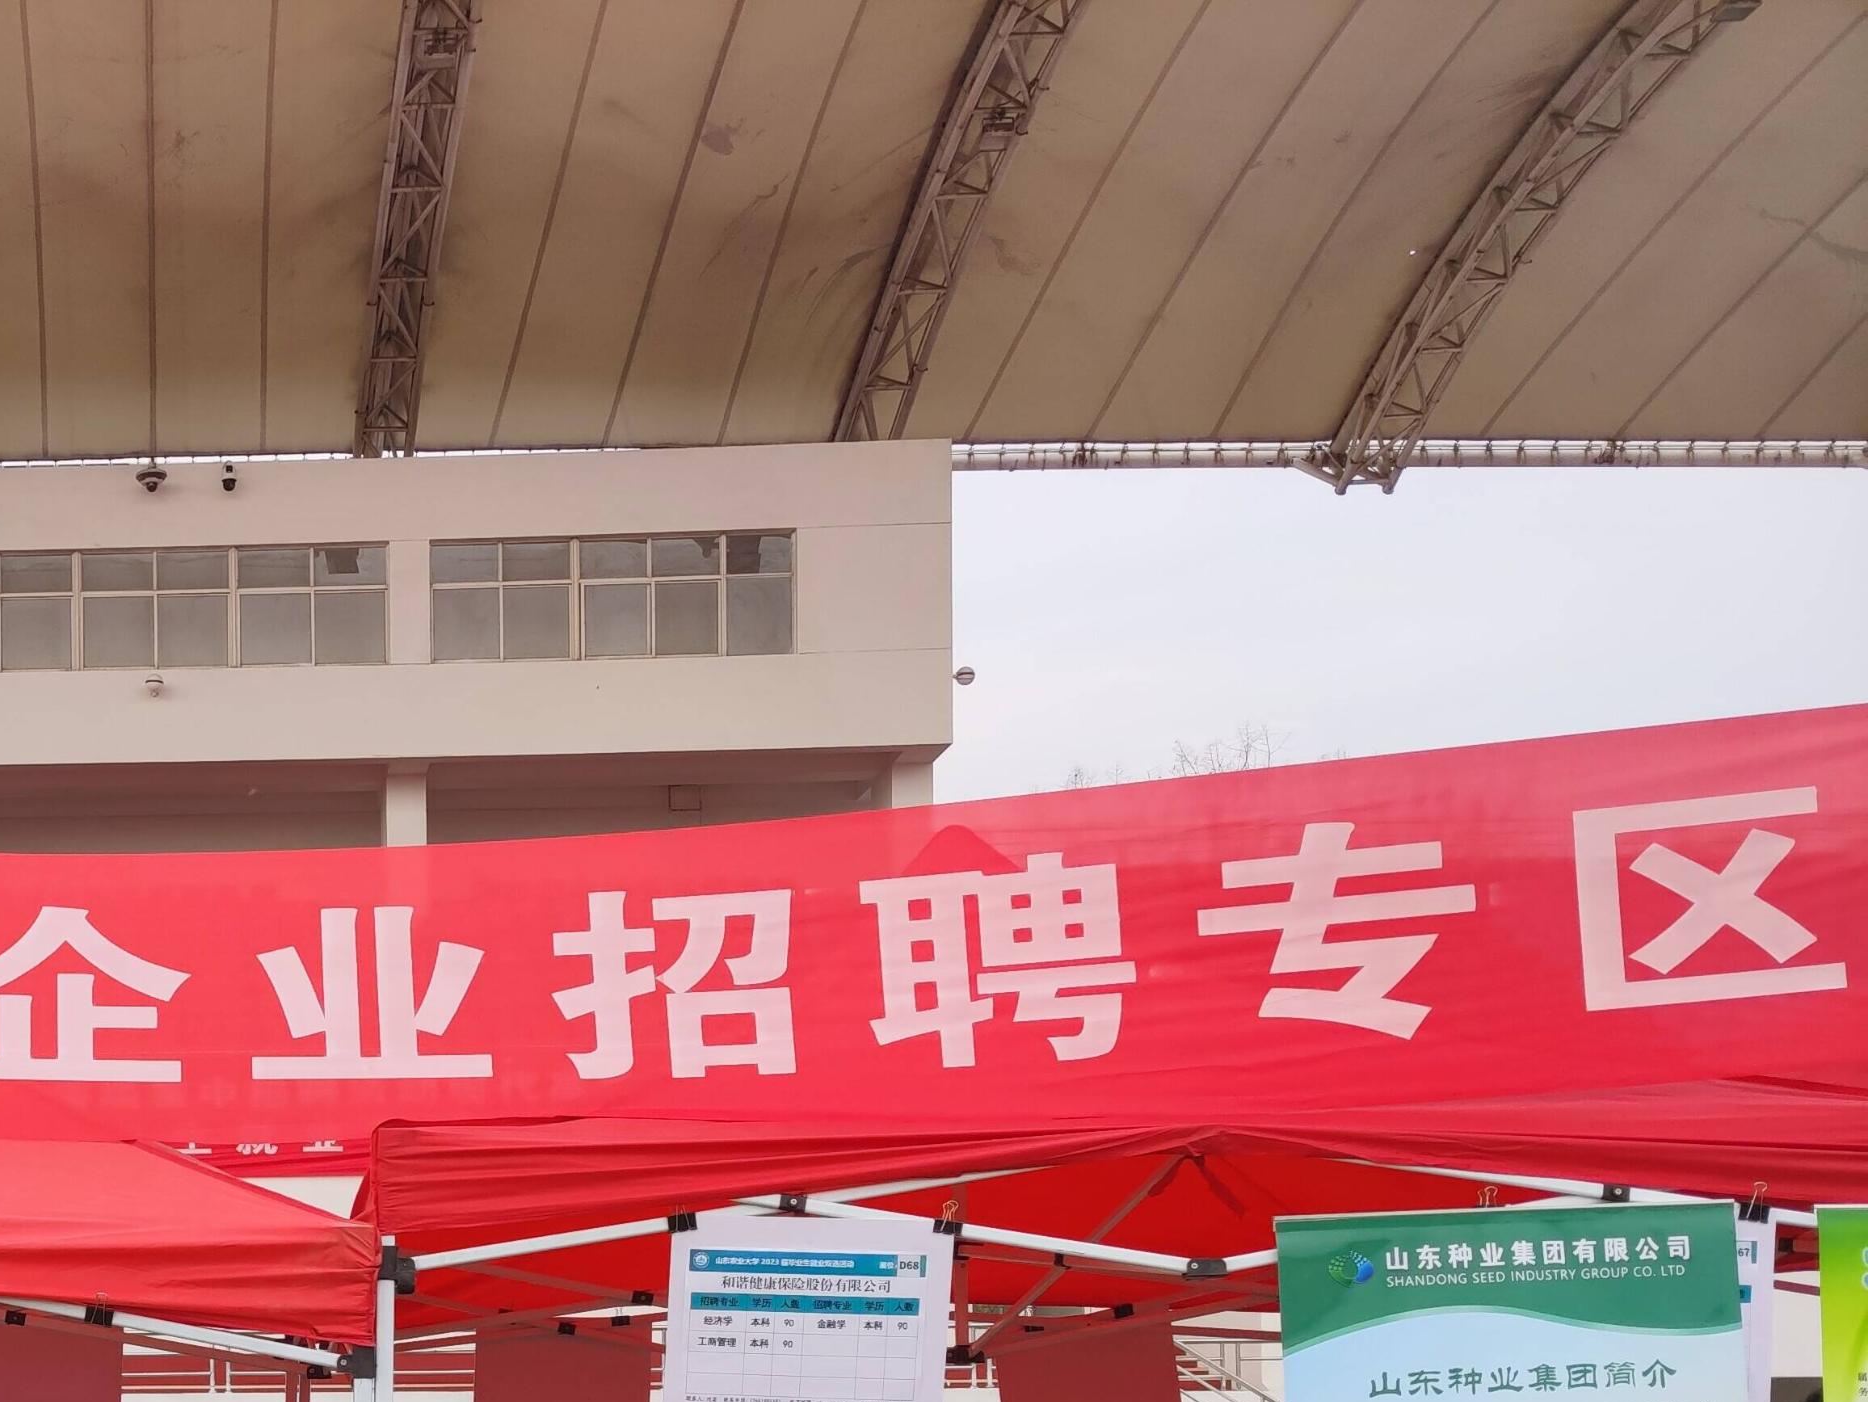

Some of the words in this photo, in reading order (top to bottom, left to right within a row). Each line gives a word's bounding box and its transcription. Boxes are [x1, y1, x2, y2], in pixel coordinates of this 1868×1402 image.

[1385, 1235, 1692, 1271] 山东种业集团有限公司
[761, 1258, 780, 1266] 2023
[899, 1261, 920, 1271] D68
[721, 1275, 891, 1293] 和谐健康保险股份有限公司
[1386, 1272, 1468, 1288] SHANDONG
[1472, 1271, 1506, 1285] SEED
[1511, 1269, 1577, 1283] INDUSTRY
[1581, 1267, 1629, 1281] GROUP
[1634, 1266, 1656, 1278] CO.
[1661, 1265, 1686, 1278] LTD
[700, 1296, 740, 1308] 招聘专业
[751, 1298, 772, 1309] 学历
[813, 1300, 852, 1312] 招聘专业
[864, 1301, 884, 1312] 学历
[894, 1301, 914, 1313] 人数
[703, 1315, 733, 1326] 经济学
[750, 1317, 770, 1328] 本科
[784, 1318, 795, 1328] 90
[817, 1319, 847, 1330] 金融学
[863, 1319, 883, 1331] 本科
[897, 1321, 908, 1331] 90
[697, 1336, 737, 1348] 工商管理
[749, 1338, 769, 1349] 本科
[782, 1339, 793, 1349] 90
[1369, 1359, 1677, 1398] 山东种业集团简介
